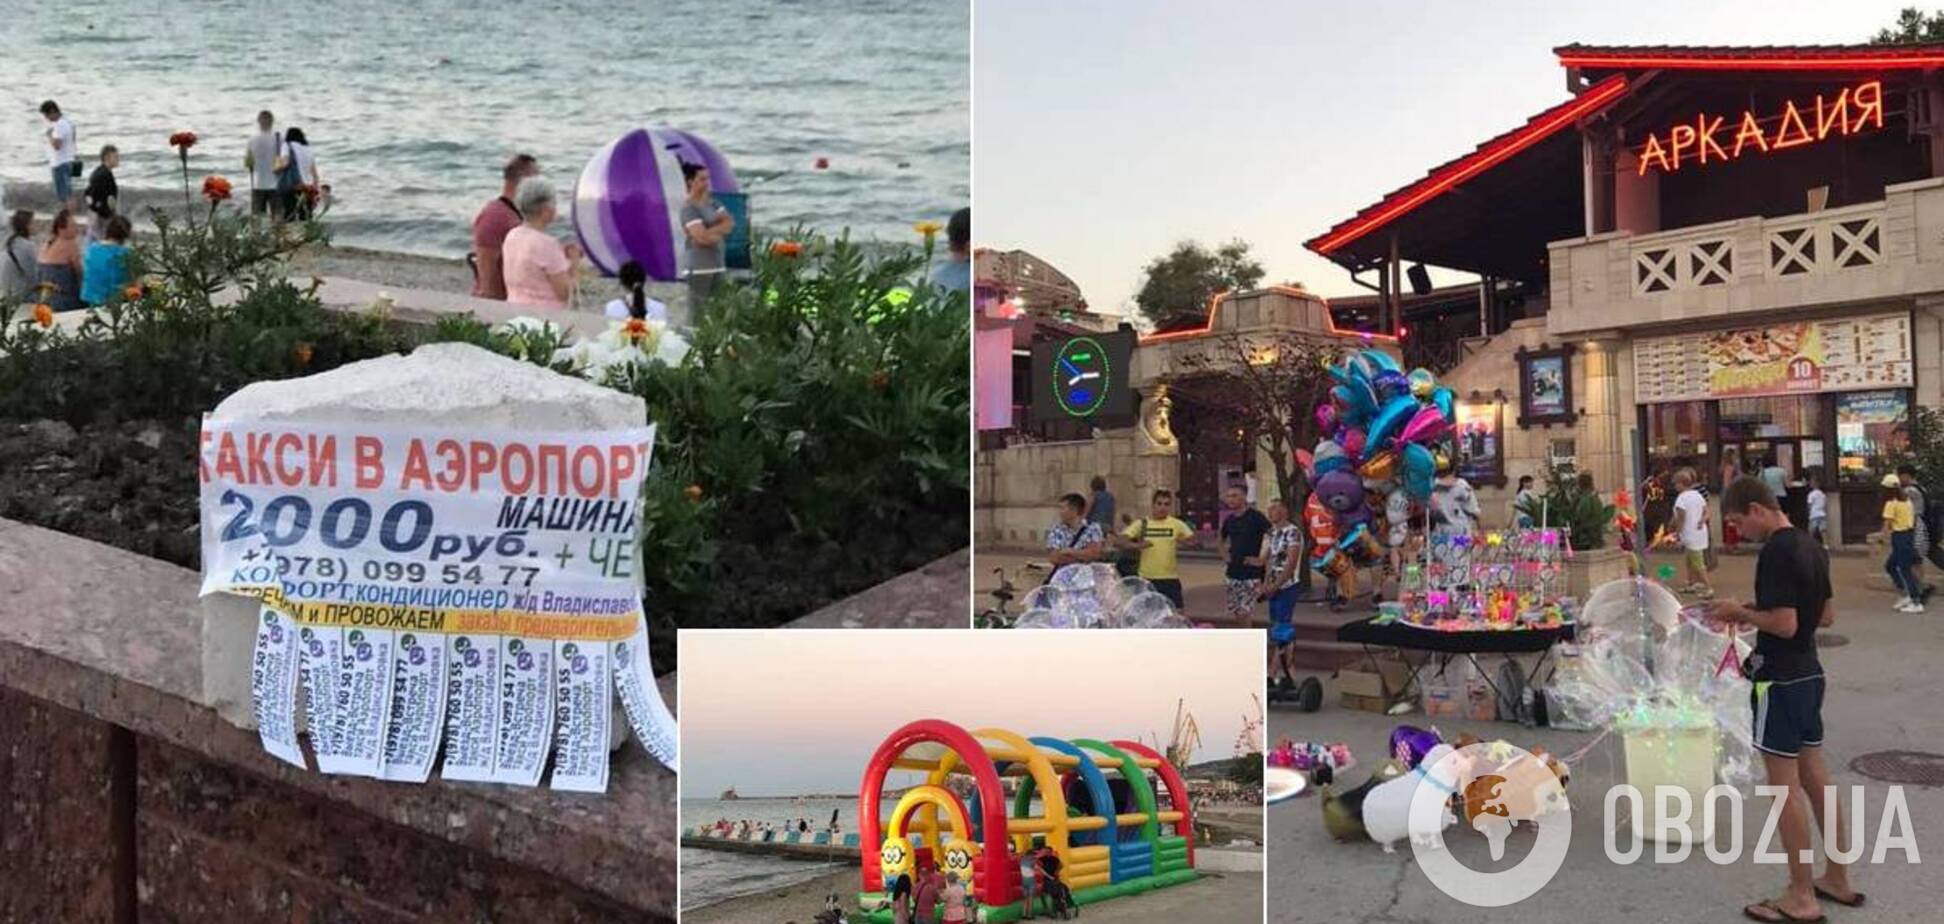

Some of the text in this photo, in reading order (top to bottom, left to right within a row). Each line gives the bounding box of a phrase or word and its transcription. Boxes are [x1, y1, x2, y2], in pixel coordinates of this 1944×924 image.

[1638, 80, 1883, 176] АРКАДИЯ
[1791, 361, 1812, 378] 10
[355, 436, 384, 489] В
[401, 437, 648, 499] АЭРОПОРТ
[220, 489, 538, 562] 2000 руб.
[363, 560, 426, 582] 099
[442, 565, 483, 584] 54
[500, 566, 540, 587] 77
[308, 609, 319, 623] и
[324, 604, 446, 630] ПРОВОЖАЕМ
[258, 633, 269, 649] 55
[255, 651, 266, 667] 50
[300, 651, 309, 664] 77
[343, 655, 355, 669] 55
[396, 658, 408, 673] 77
[450, 662, 463, 677] 55
[504, 664, 516, 679] 77
[558, 668, 571, 684] 55
[341, 673, 352, 687] 50
[394, 678, 407, 692] 54
[449, 680, 462, 695] 50
[503, 683, 514, 698] 54
[558, 688, 571, 702] 50
[337, 690, 350, 711] 760
[390, 696, 406, 719] 099
[448, 699, 461, 720] 760
[557, 706, 570, 729] 760
